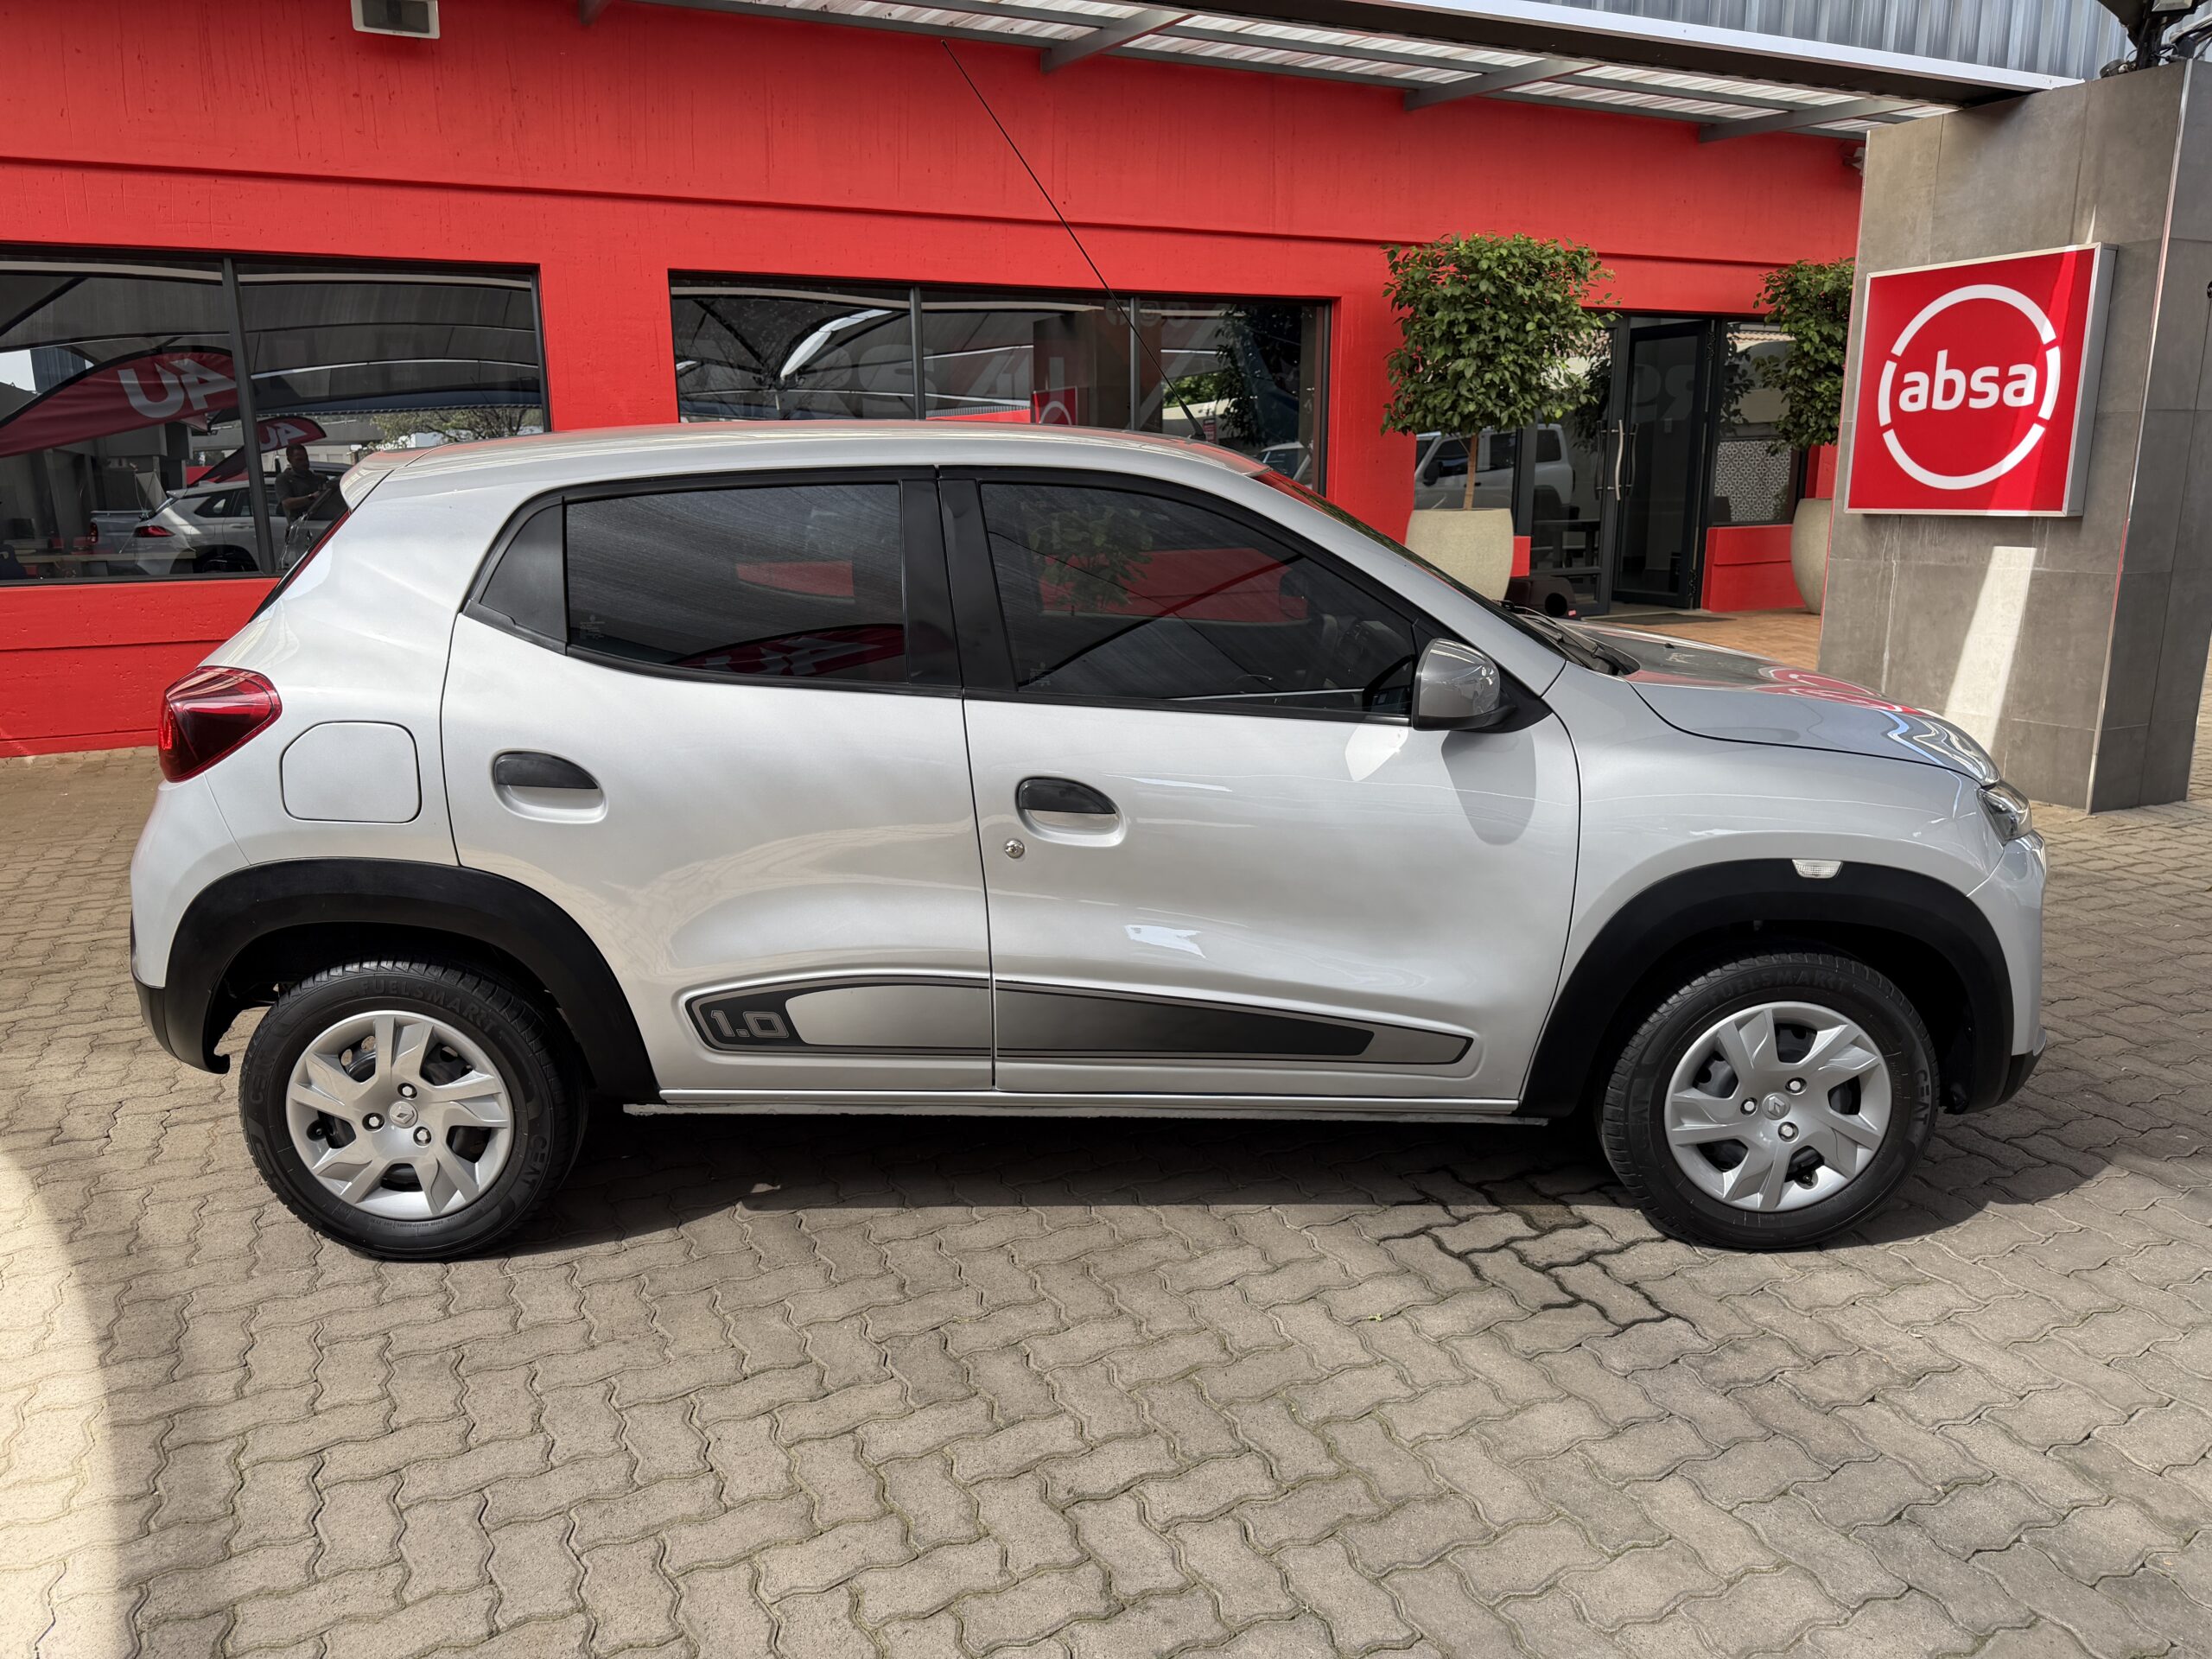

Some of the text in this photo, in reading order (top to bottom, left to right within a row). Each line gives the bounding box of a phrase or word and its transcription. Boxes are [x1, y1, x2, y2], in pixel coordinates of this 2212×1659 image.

[1898, 349, 2038, 412] absa
[710, 1009, 789, 1038] 1.0
[521, 1133, 549, 1190] CEAT
